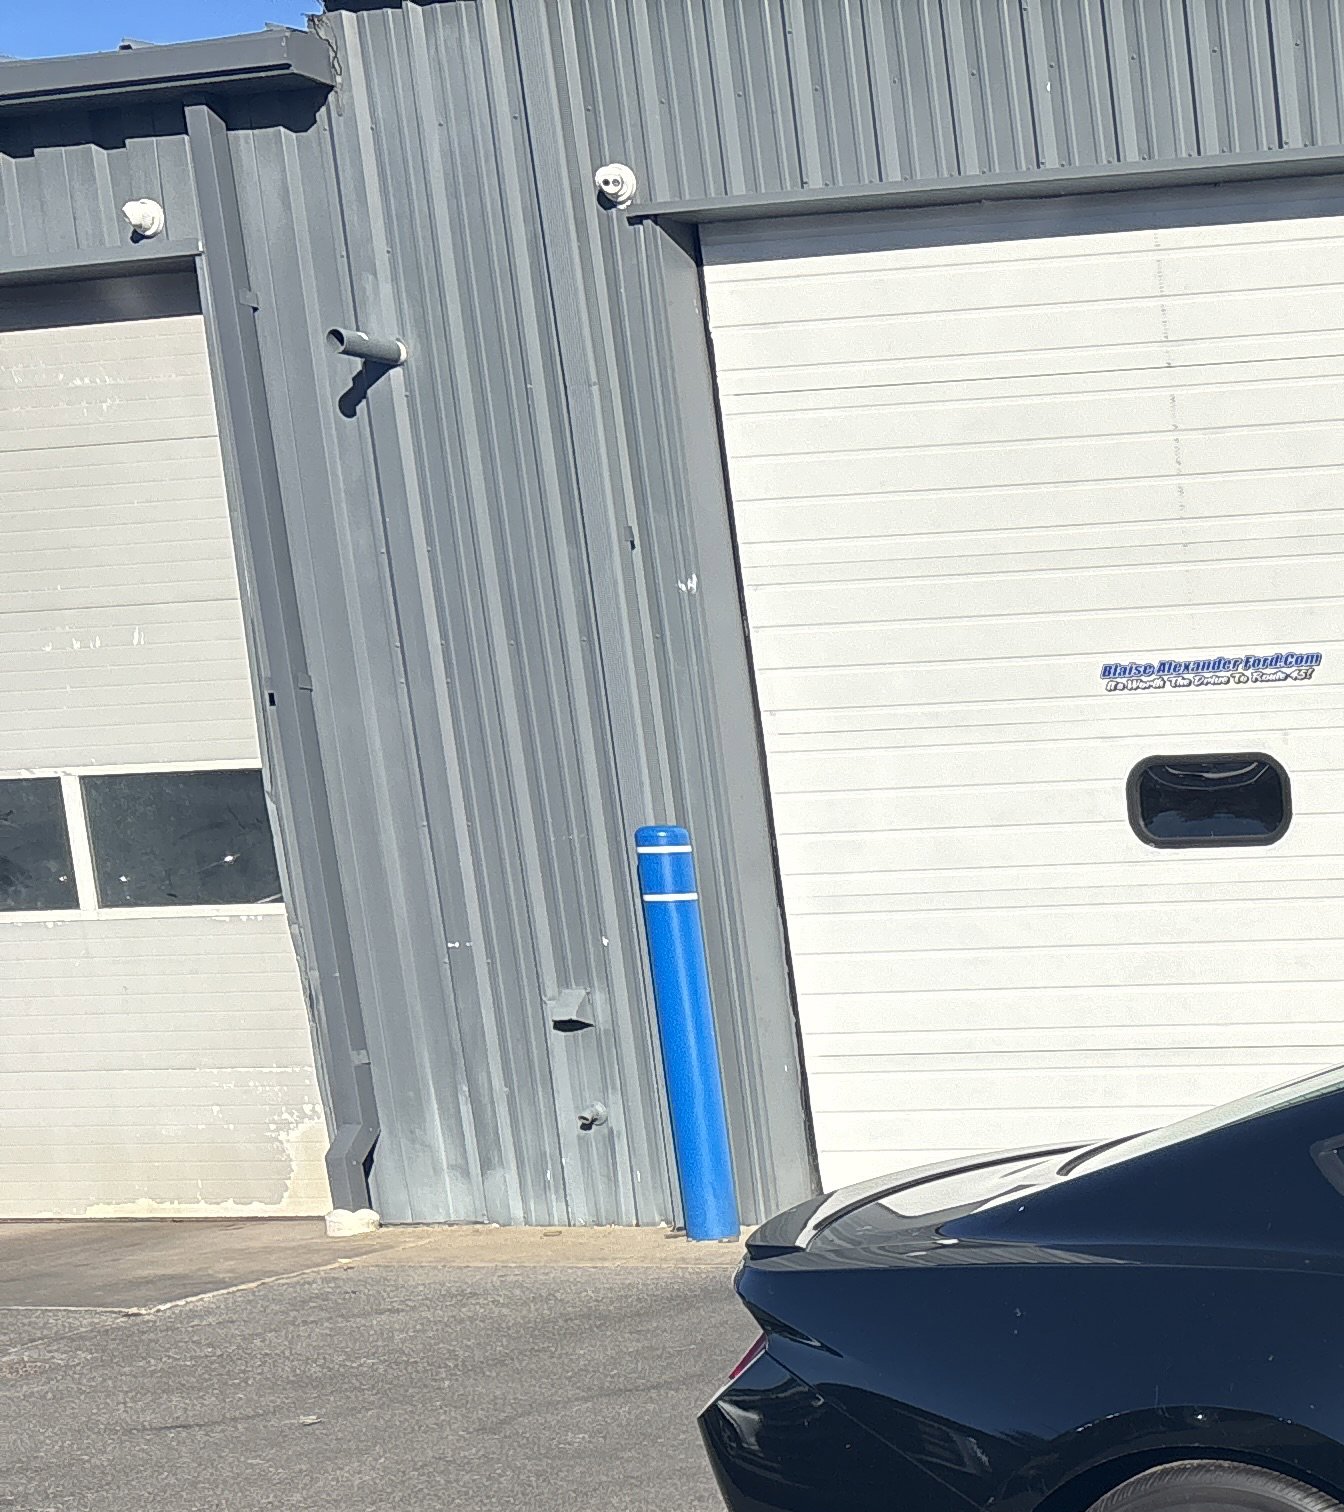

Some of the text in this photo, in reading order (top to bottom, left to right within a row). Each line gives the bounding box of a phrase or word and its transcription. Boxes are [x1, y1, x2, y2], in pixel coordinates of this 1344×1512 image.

[1167, 676, 1192, 688] The
[1230, 672, 1249, 684] To
[1251, 670, 1288, 682] Route
